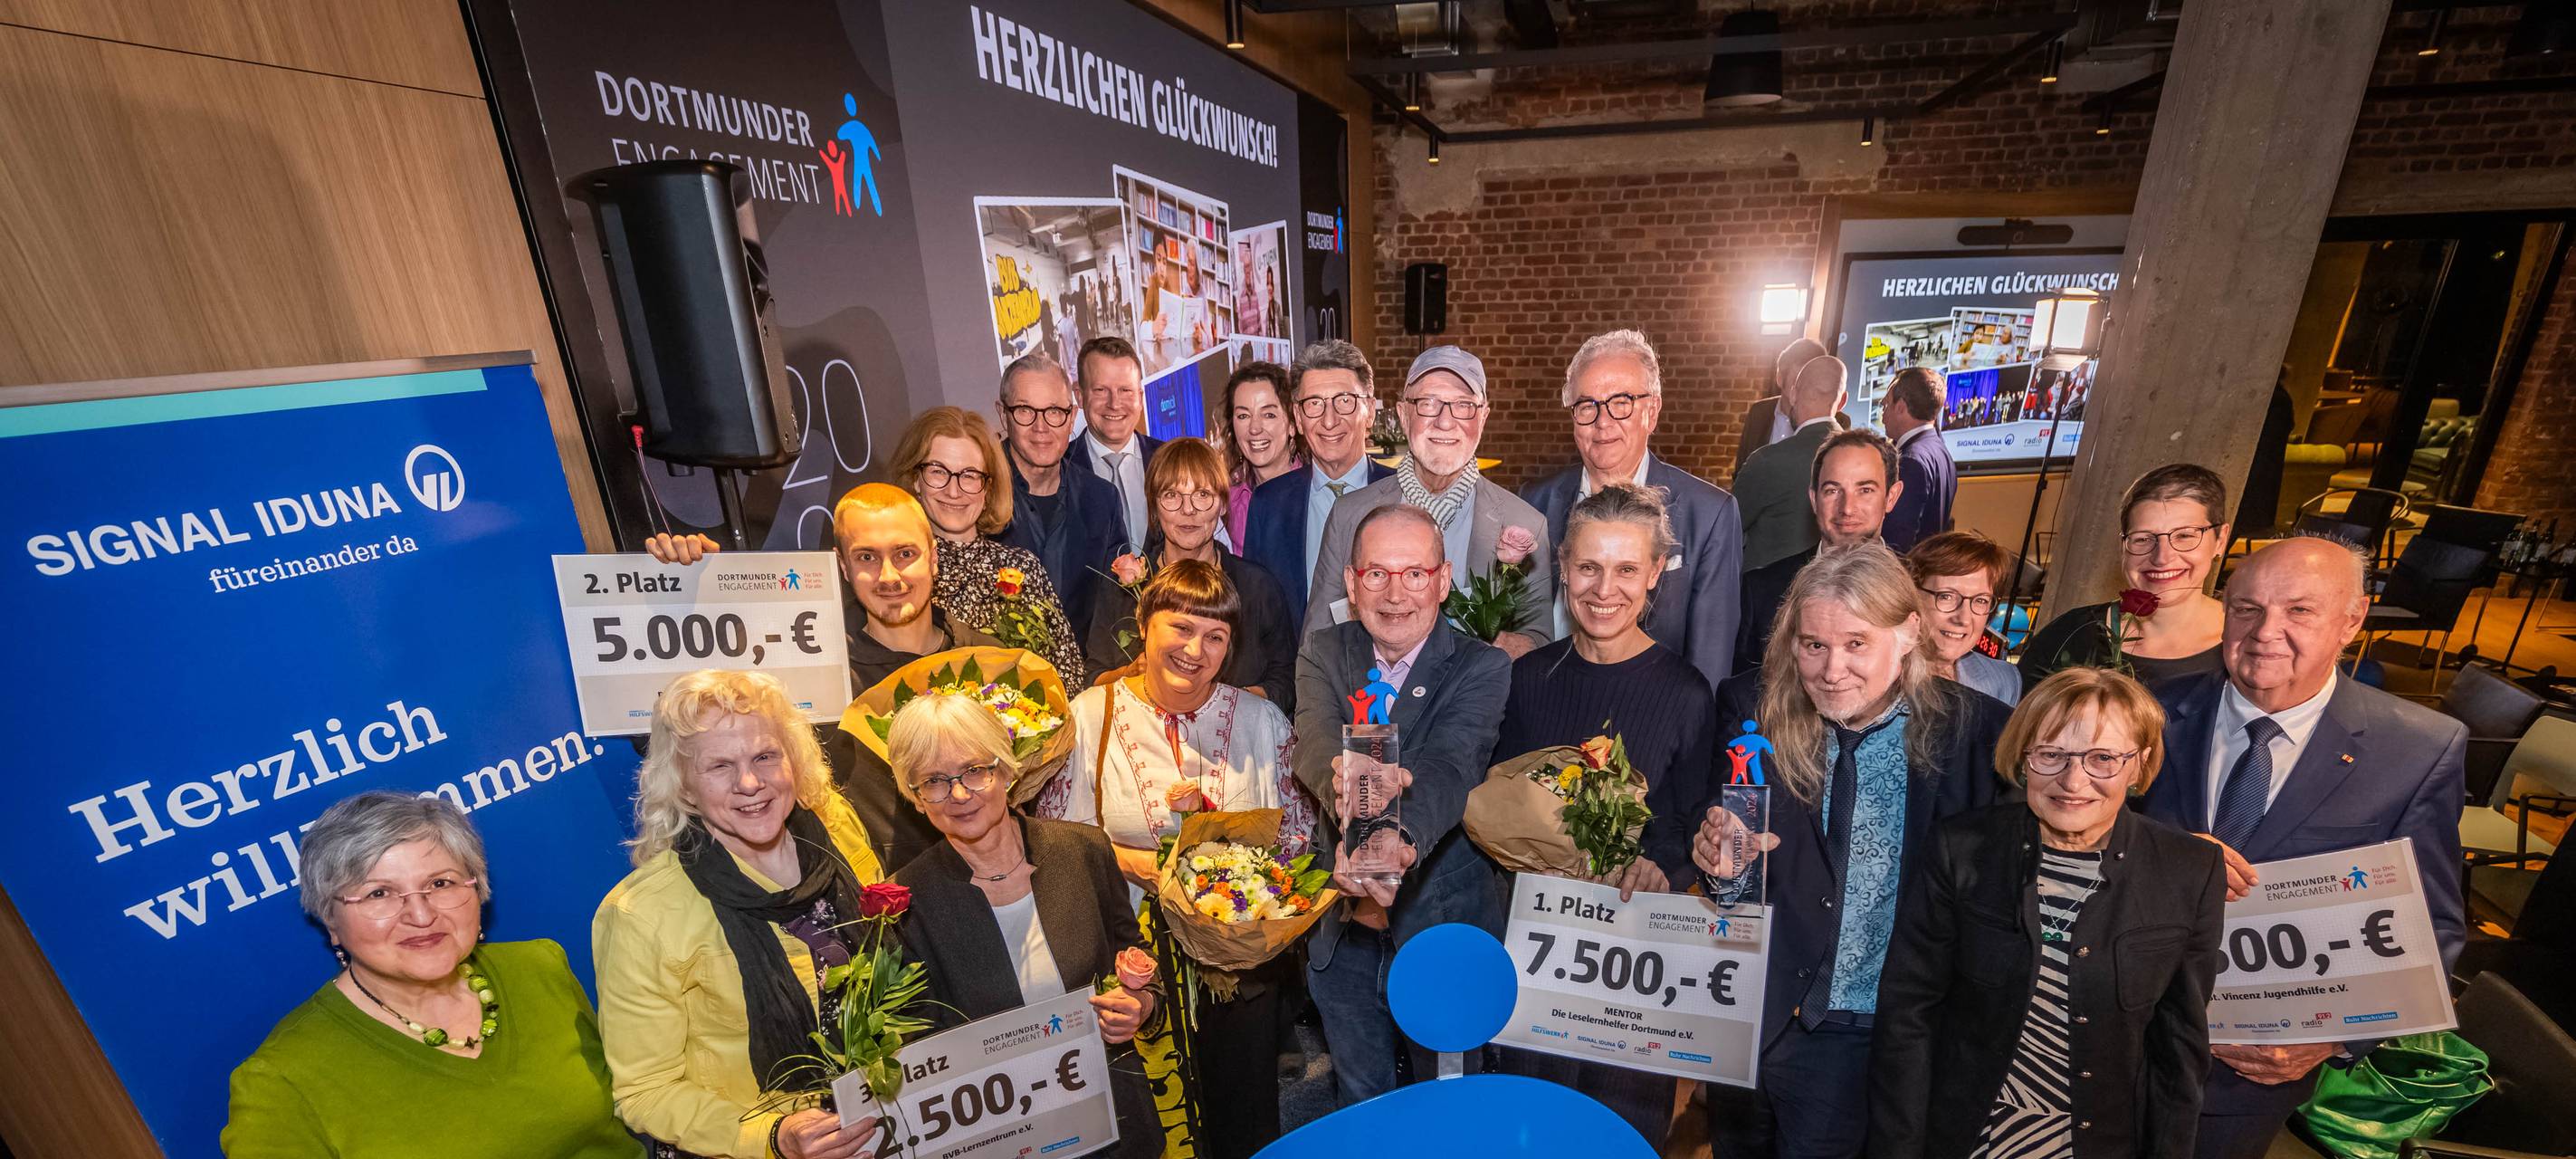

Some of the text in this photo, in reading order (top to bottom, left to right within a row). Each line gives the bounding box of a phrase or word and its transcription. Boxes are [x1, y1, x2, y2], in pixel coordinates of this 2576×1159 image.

[970, 5, 1278, 168] HERZLICHEN GLÜCKWUNSCH!
[595, 71, 815, 148] DORTMUNDER
[1882, 275, 1988, 297] HERZLICHEN
[1982, 438, 2002, 446] IDUNA
[27, 483, 403, 577] SIGNAL IDUNA
[209, 534, 419, 593] füreinander da
[584, 571, 682, 595] 2. Platz
[717, 573, 778, 581] DORTMUNDER
[718, 582, 778, 591] ENGAGEMENT
[790, 610, 823, 654] €
[69, 700, 448, 863] Herzlich
[2265, 875, 2337, 892] DORTMUNDER
[2266, 884, 2340, 901] ENGAGEMENT
[1533, 892, 1616, 924] 1. Platz
[1650, 912, 1707, 924] DORTMUNDER
[1648, 921, 1706, 934] ENGAGEMENT
[1707, 960, 1740, 1006] €
[2222, 991, 2262, 1001] Vincenz
[2263, 984, 2326, 1001] Jugendhilfe
[2329, 984, 2349, 994] e.V.
[1550, 1008, 1694, 1040] Die Leselernhelfer Dortmund e.V.
[1604, 1007, 1643, 1021] MENTOR
[2301, 1019, 2323, 1028] radio
[983, 1023, 1040, 1046] DORTMUNDER
[984, 1031, 1041, 1055] ENGAGEMENT
[1577, 1035, 1616, 1048] SIGNAL IDUNA
[1634, 1046, 1652, 1054] radio
[903, 1053, 949, 1084] latz
[1053, 1049, 1087, 1092] €
[942, 1123, 1034, 1159] BVB-Lernzentrum e.V.
